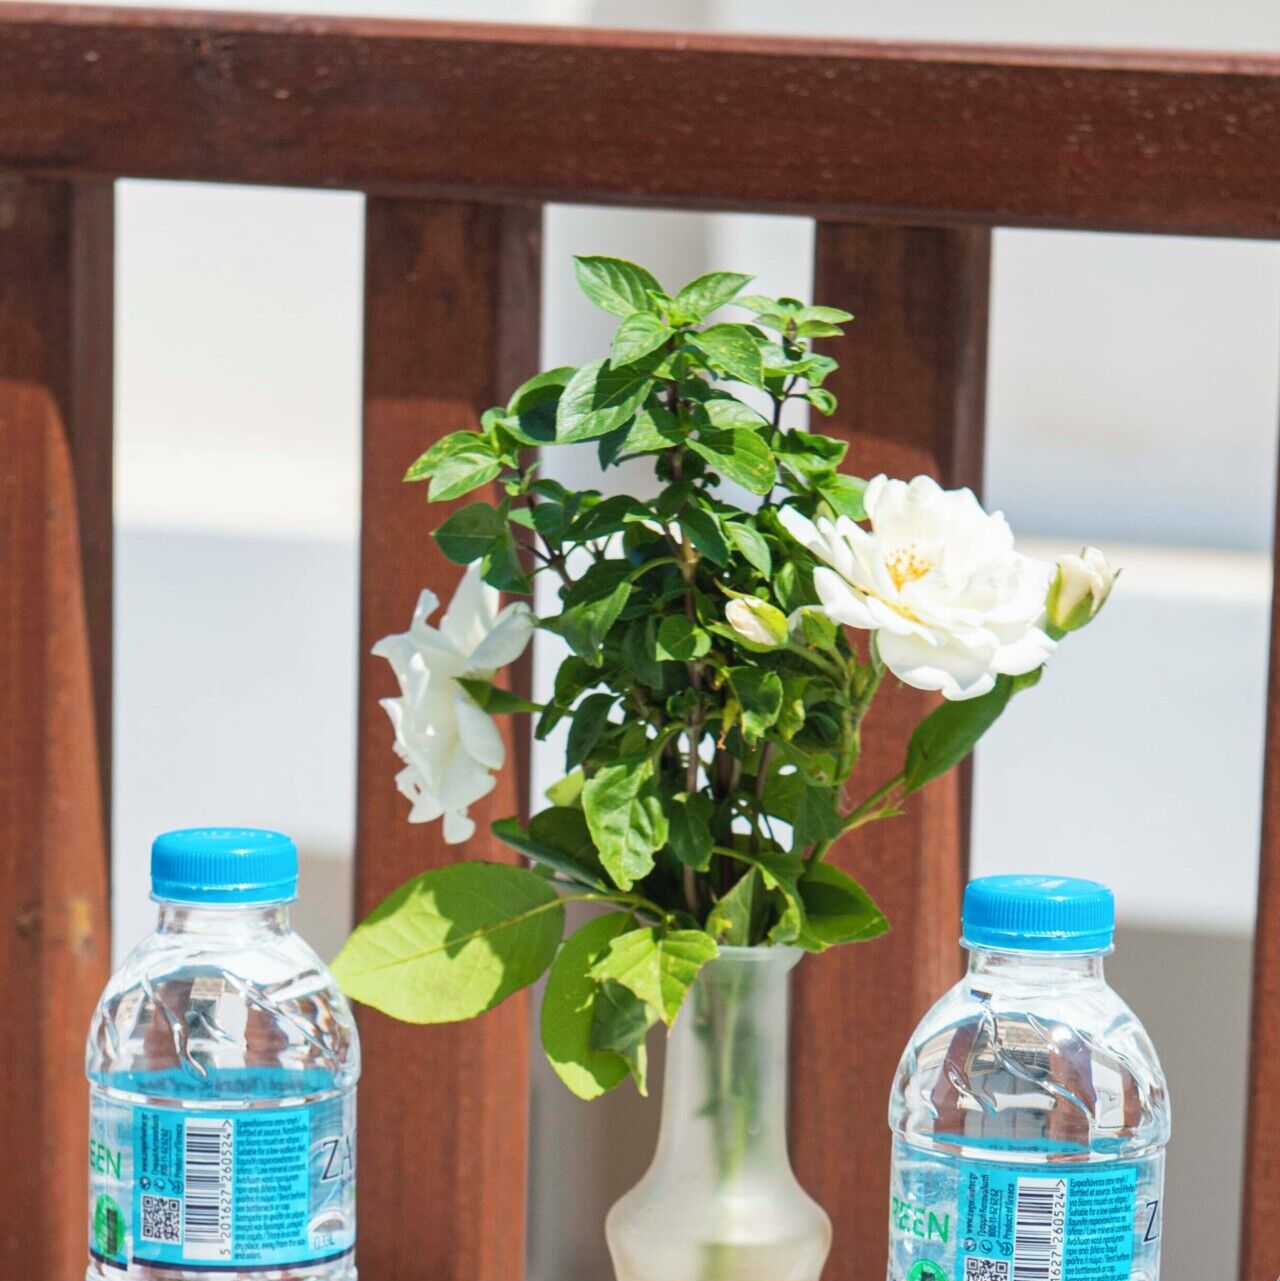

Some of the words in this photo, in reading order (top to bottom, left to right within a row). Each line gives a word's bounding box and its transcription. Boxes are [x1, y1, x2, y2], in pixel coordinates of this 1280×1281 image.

[220, 1133, 232, 1181] 260524
[220, 1191, 231, 1238] 201627
[1005, 1184, 1015, 1205] Greece
[1053, 1193, 1065, 1243] 260524
[1003, 1214, 1012, 1239] Product
